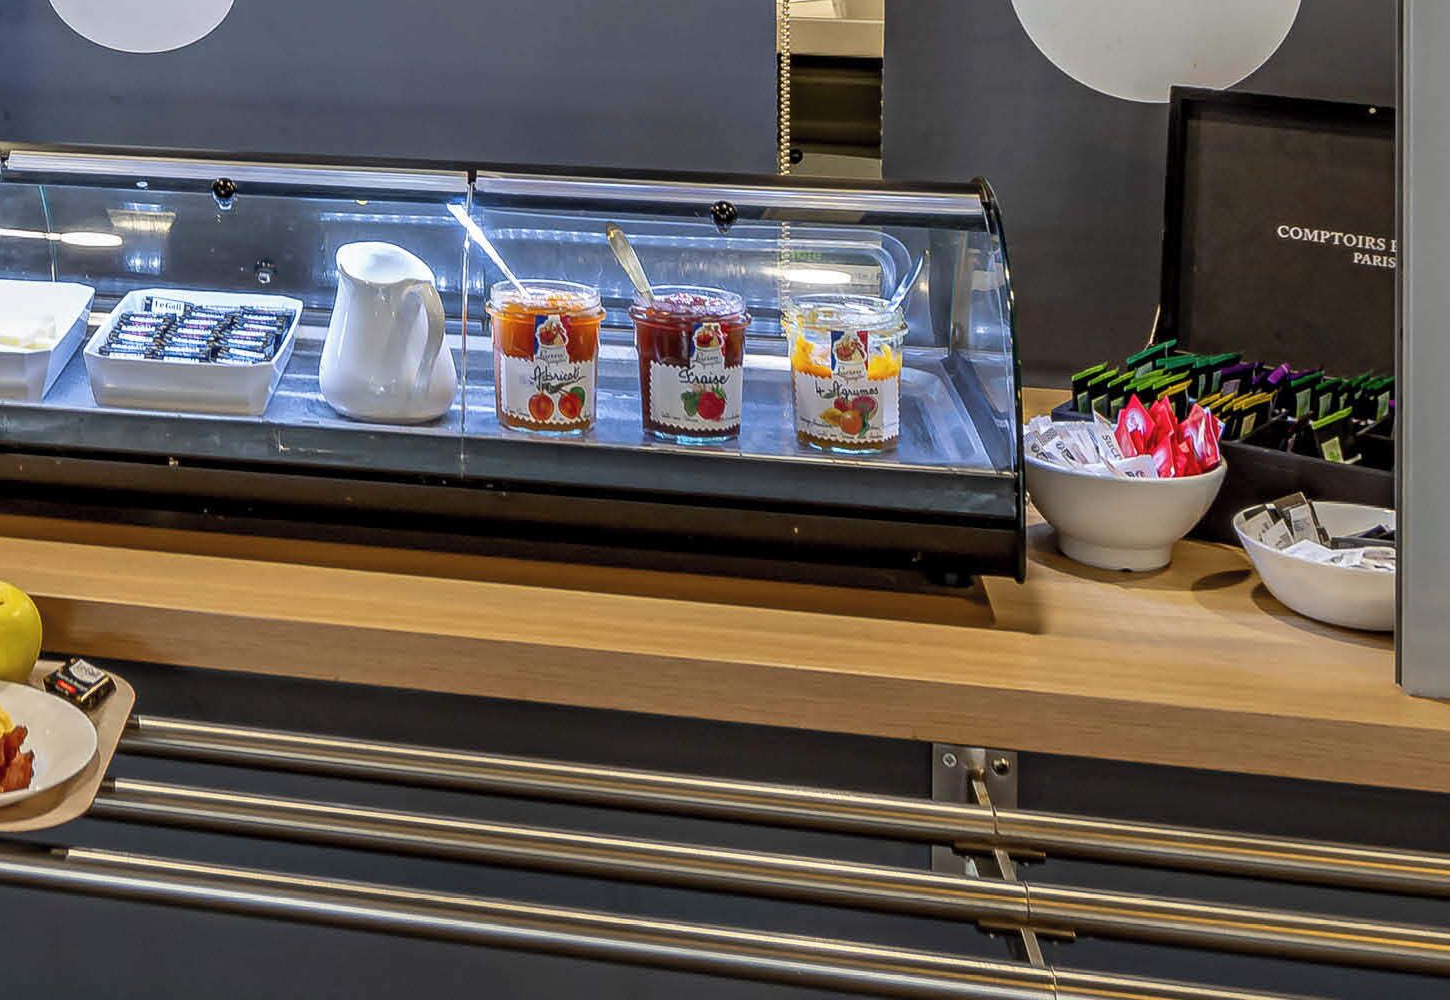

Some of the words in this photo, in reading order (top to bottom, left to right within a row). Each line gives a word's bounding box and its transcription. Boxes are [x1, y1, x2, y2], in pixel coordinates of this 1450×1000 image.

[1276, 225, 1386, 251] COMPTOIRS
[1353, 252, 1396, 268] PARIS
[678, 364, 730, 385] Fraise
